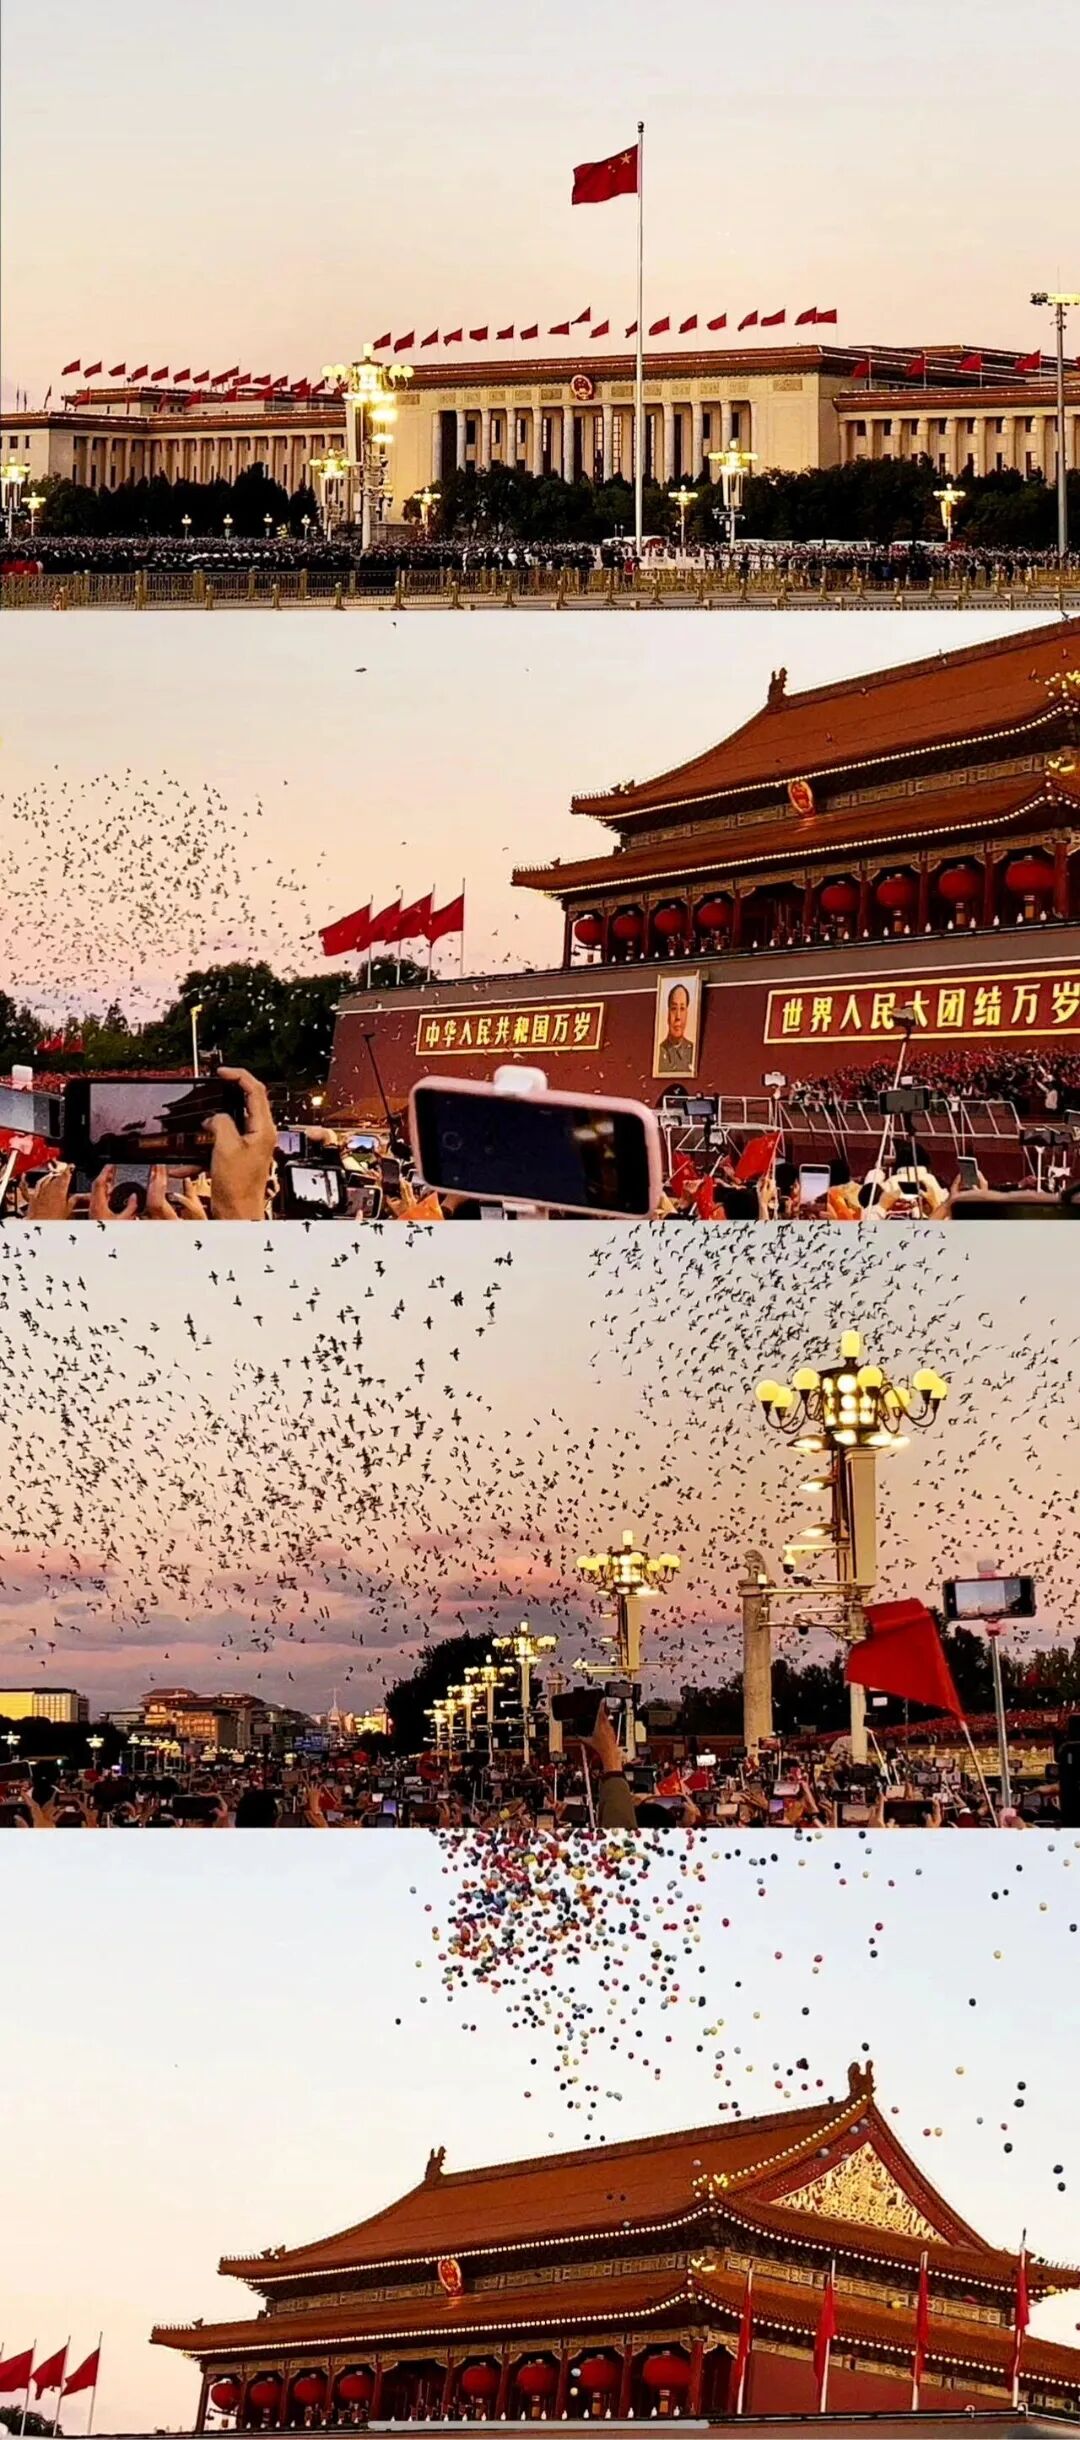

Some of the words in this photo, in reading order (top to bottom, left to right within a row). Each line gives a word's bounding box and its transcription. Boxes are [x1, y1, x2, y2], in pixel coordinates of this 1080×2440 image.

[425, 1011, 591, 1048] 中华人民共和国万岁
[782, 981, 1080, 1034] 世界人民大团结万岁
